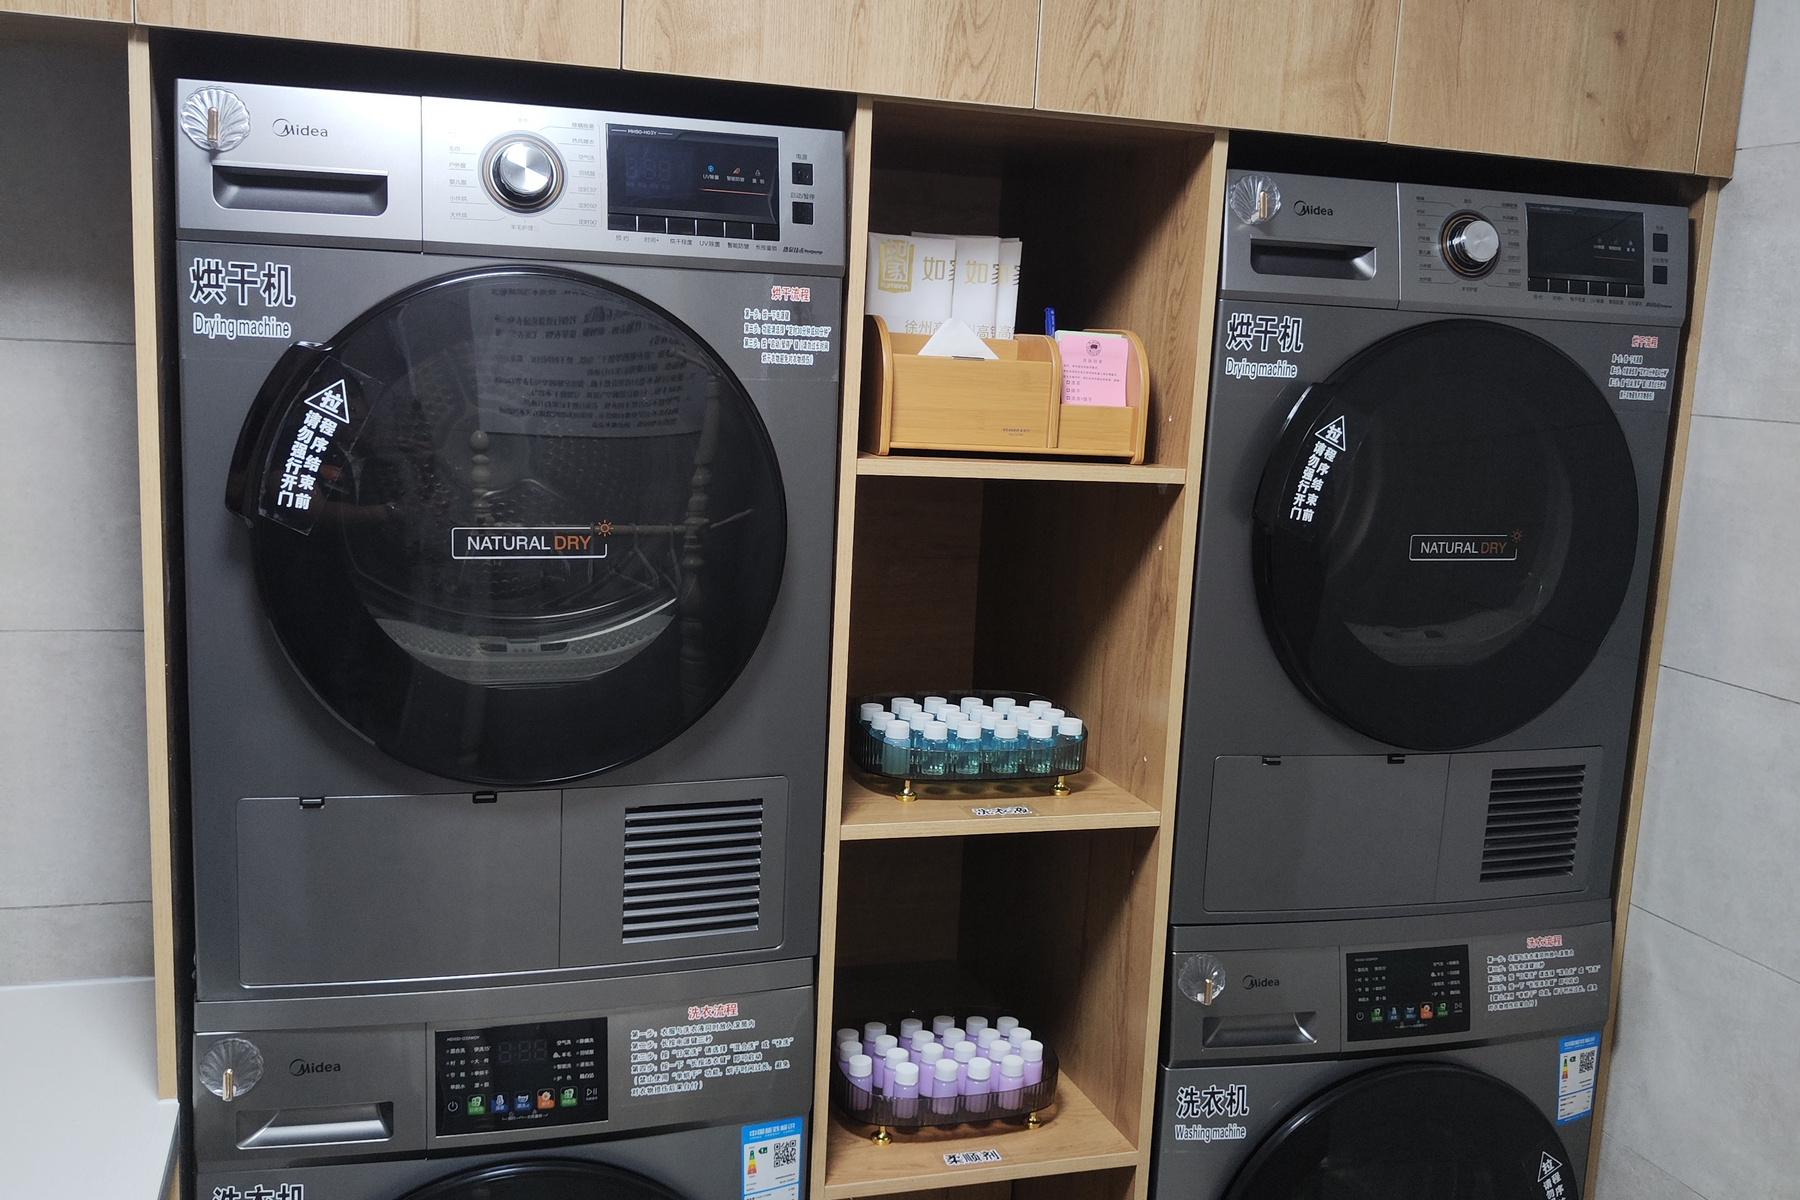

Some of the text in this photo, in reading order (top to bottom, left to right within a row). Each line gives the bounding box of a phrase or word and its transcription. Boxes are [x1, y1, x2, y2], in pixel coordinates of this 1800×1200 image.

[272, 118, 328, 138] Midea
[1293, 200, 1334, 216] Midea
[189, 257, 296, 307] 烘干机
[192, 312, 291, 340] Drying machine
[1225, 312, 1304, 353] 烘干机
[1225, 357, 1298, 380] Drying machine
[319, 390, 344, 414] 拉
[1325, 424, 1342, 444] 拉
[277, 409, 323, 508] 请勿强行开门
[294, 417, 338, 510] 程序结束前
[1289, 441, 1327, 521] 请勿强行开门
[1301, 447, 1338, 523] 程序结束前
[467, 535, 592, 551] NATURAL DRY
[1420, 541, 1507, 554] NATURAL DRY
[1242, 974, 1280, 990] Midea
[687, 1002, 739, 1021] 洗衣流程
[289, 1058, 342, 1077] Midea
[1175, 1083, 1250, 1119] 洗衣机
[1174, 1123, 1247, 1144] Washing machine
